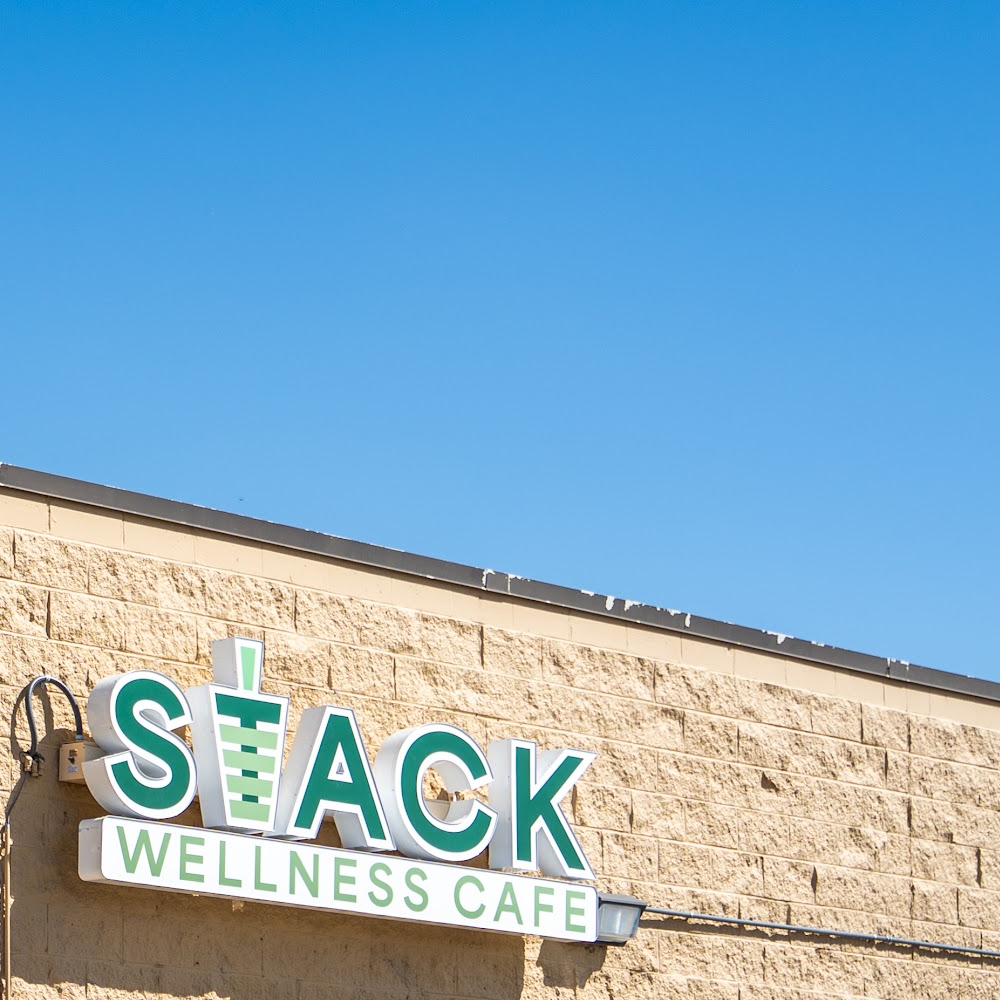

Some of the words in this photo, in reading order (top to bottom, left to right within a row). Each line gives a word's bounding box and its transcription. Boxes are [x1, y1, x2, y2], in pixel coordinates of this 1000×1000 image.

[105, 643, 590, 872] STACK
[116, 825, 430, 914] WELLNESS
[453, 874, 588, 933] CAFE
